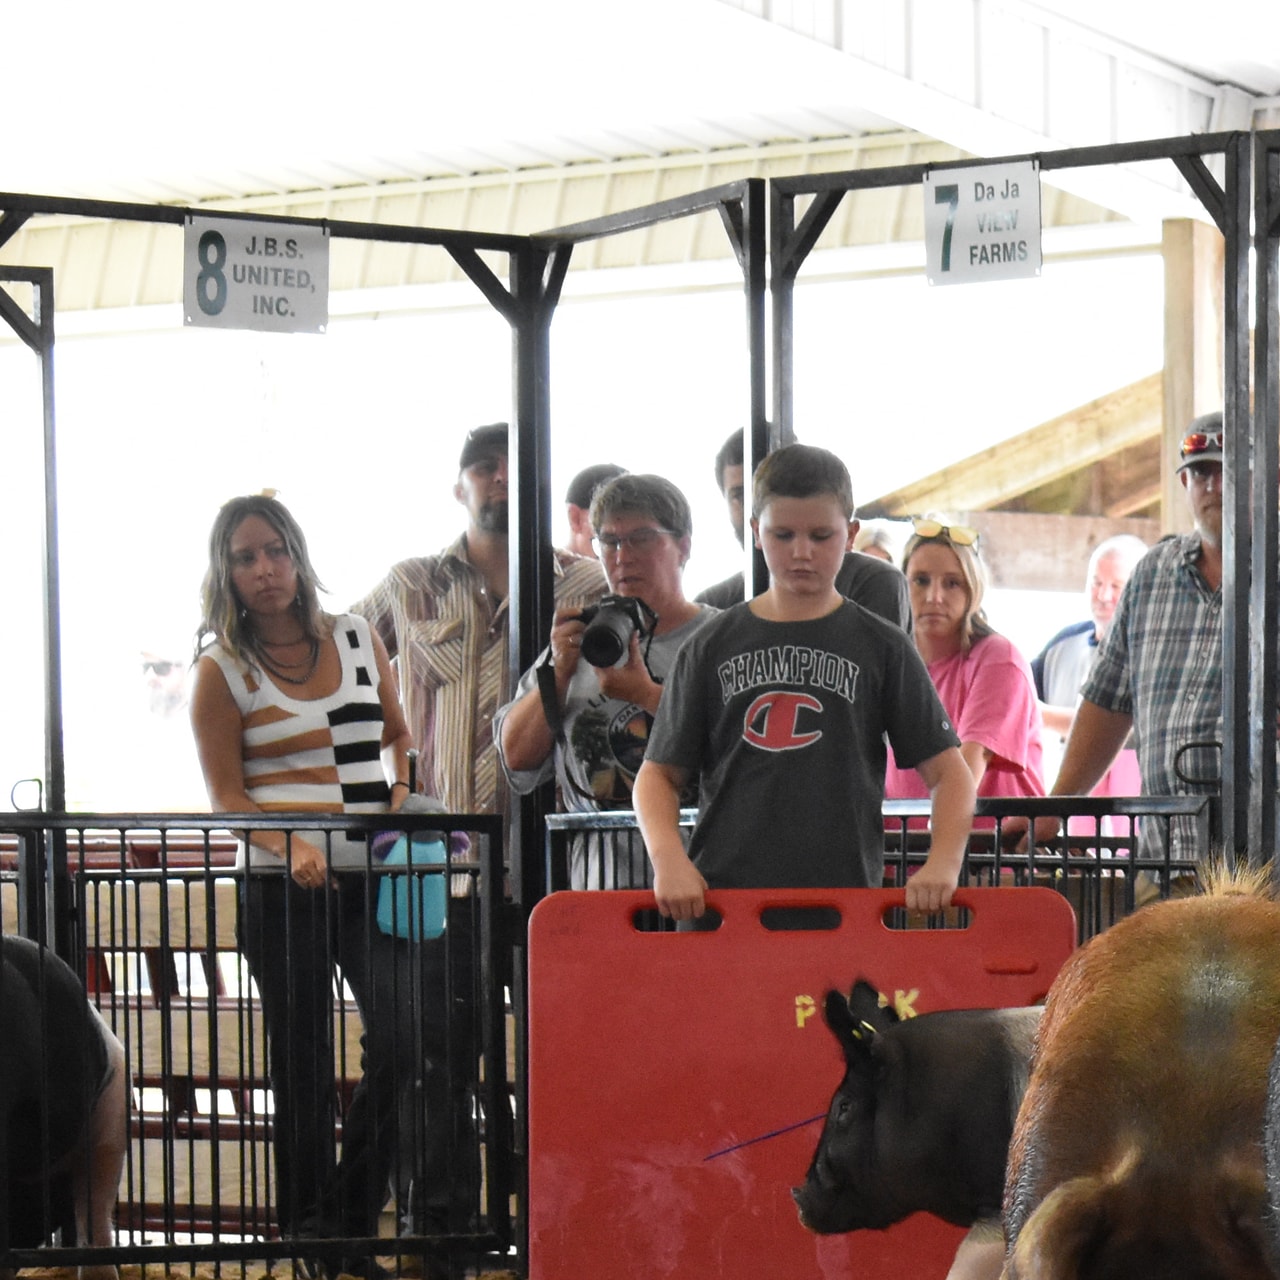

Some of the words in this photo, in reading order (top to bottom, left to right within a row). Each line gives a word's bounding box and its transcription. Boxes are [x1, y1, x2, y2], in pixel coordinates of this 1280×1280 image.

[974, 181, 995, 202] Da
[1000, 178, 1020, 200] Ja
[934, 183, 959, 272] 7
[245, 236, 304, 259] J.B.S.
[969, 240, 1028, 266] FARMS
[196, 229, 228, 317] 8
[232, 264, 316, 294] UNITED,
[252, 295, 296, 318] INC.
[718, 645, 860, 706] CHAMPION
[794, 988, 920, 1029] PK
